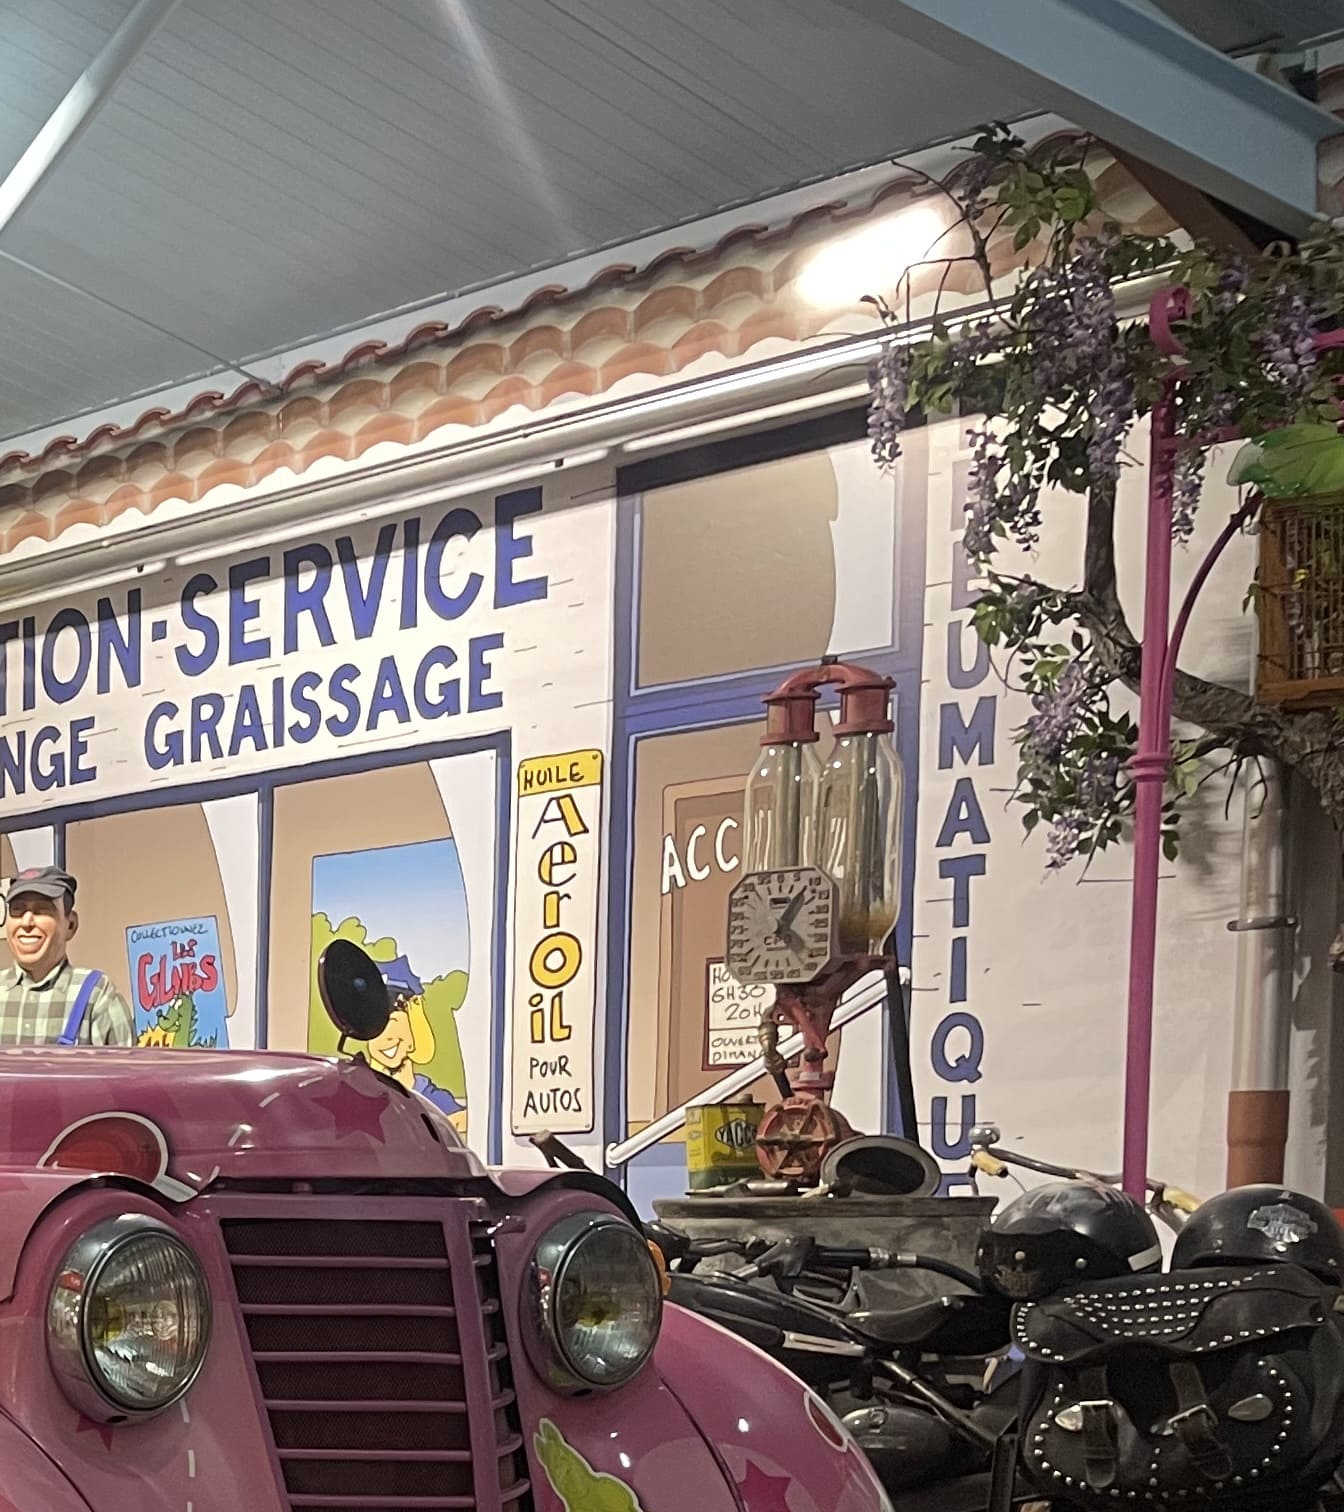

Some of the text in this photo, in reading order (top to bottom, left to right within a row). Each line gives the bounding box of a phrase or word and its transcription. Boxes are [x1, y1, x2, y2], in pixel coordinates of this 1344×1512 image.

[144, 632, 505, 770] GRAISSAGE
[523, 762, 585, 791] HUILE
[931, 424, 997, 1196] EUMATIQU
[528, 1055, 572, 1080] POUR
[523, 1087, 583, 1119] AUTOS
